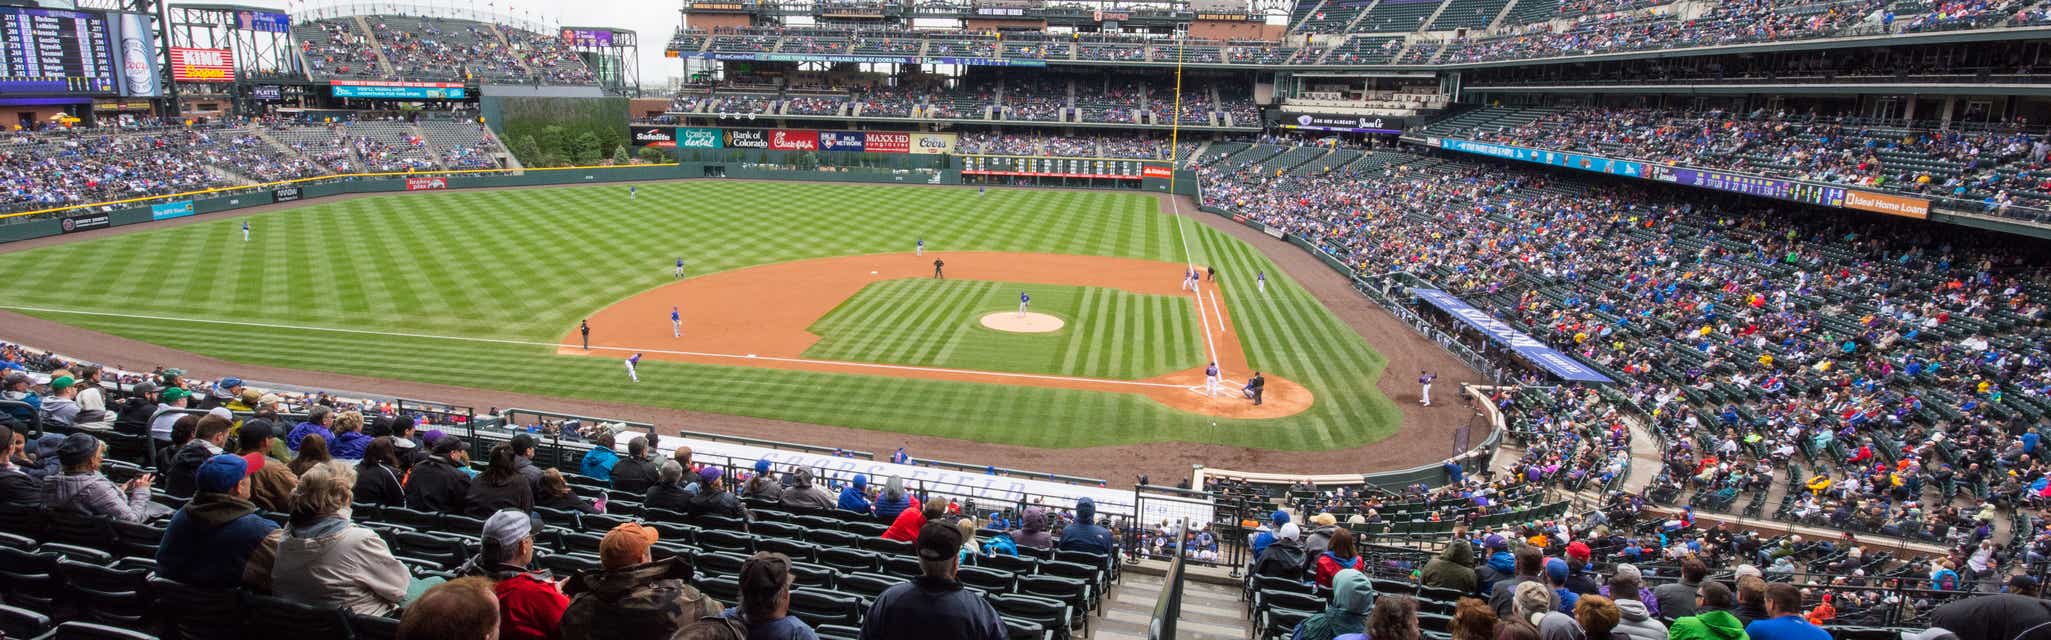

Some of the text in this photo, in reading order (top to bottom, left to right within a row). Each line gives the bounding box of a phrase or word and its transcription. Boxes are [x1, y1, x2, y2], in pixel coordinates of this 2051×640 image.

[183, 51, 223, 66] KING
[636, 132, 670, 141] Safelite
[733, 130, 761, 140] Bank of
[866, 134, 909, 143] MAXX HD
[684, 136, 715, 148] dental
[733, 139, 768, 148] Colorado
[836, 139, 862, 147] NETWORK
[919, 137, 946, 148] Coors
[1855, 196, 1928, 215] Ideal Home Loans
[764, 452, 1026, 500] COORS FIELD
